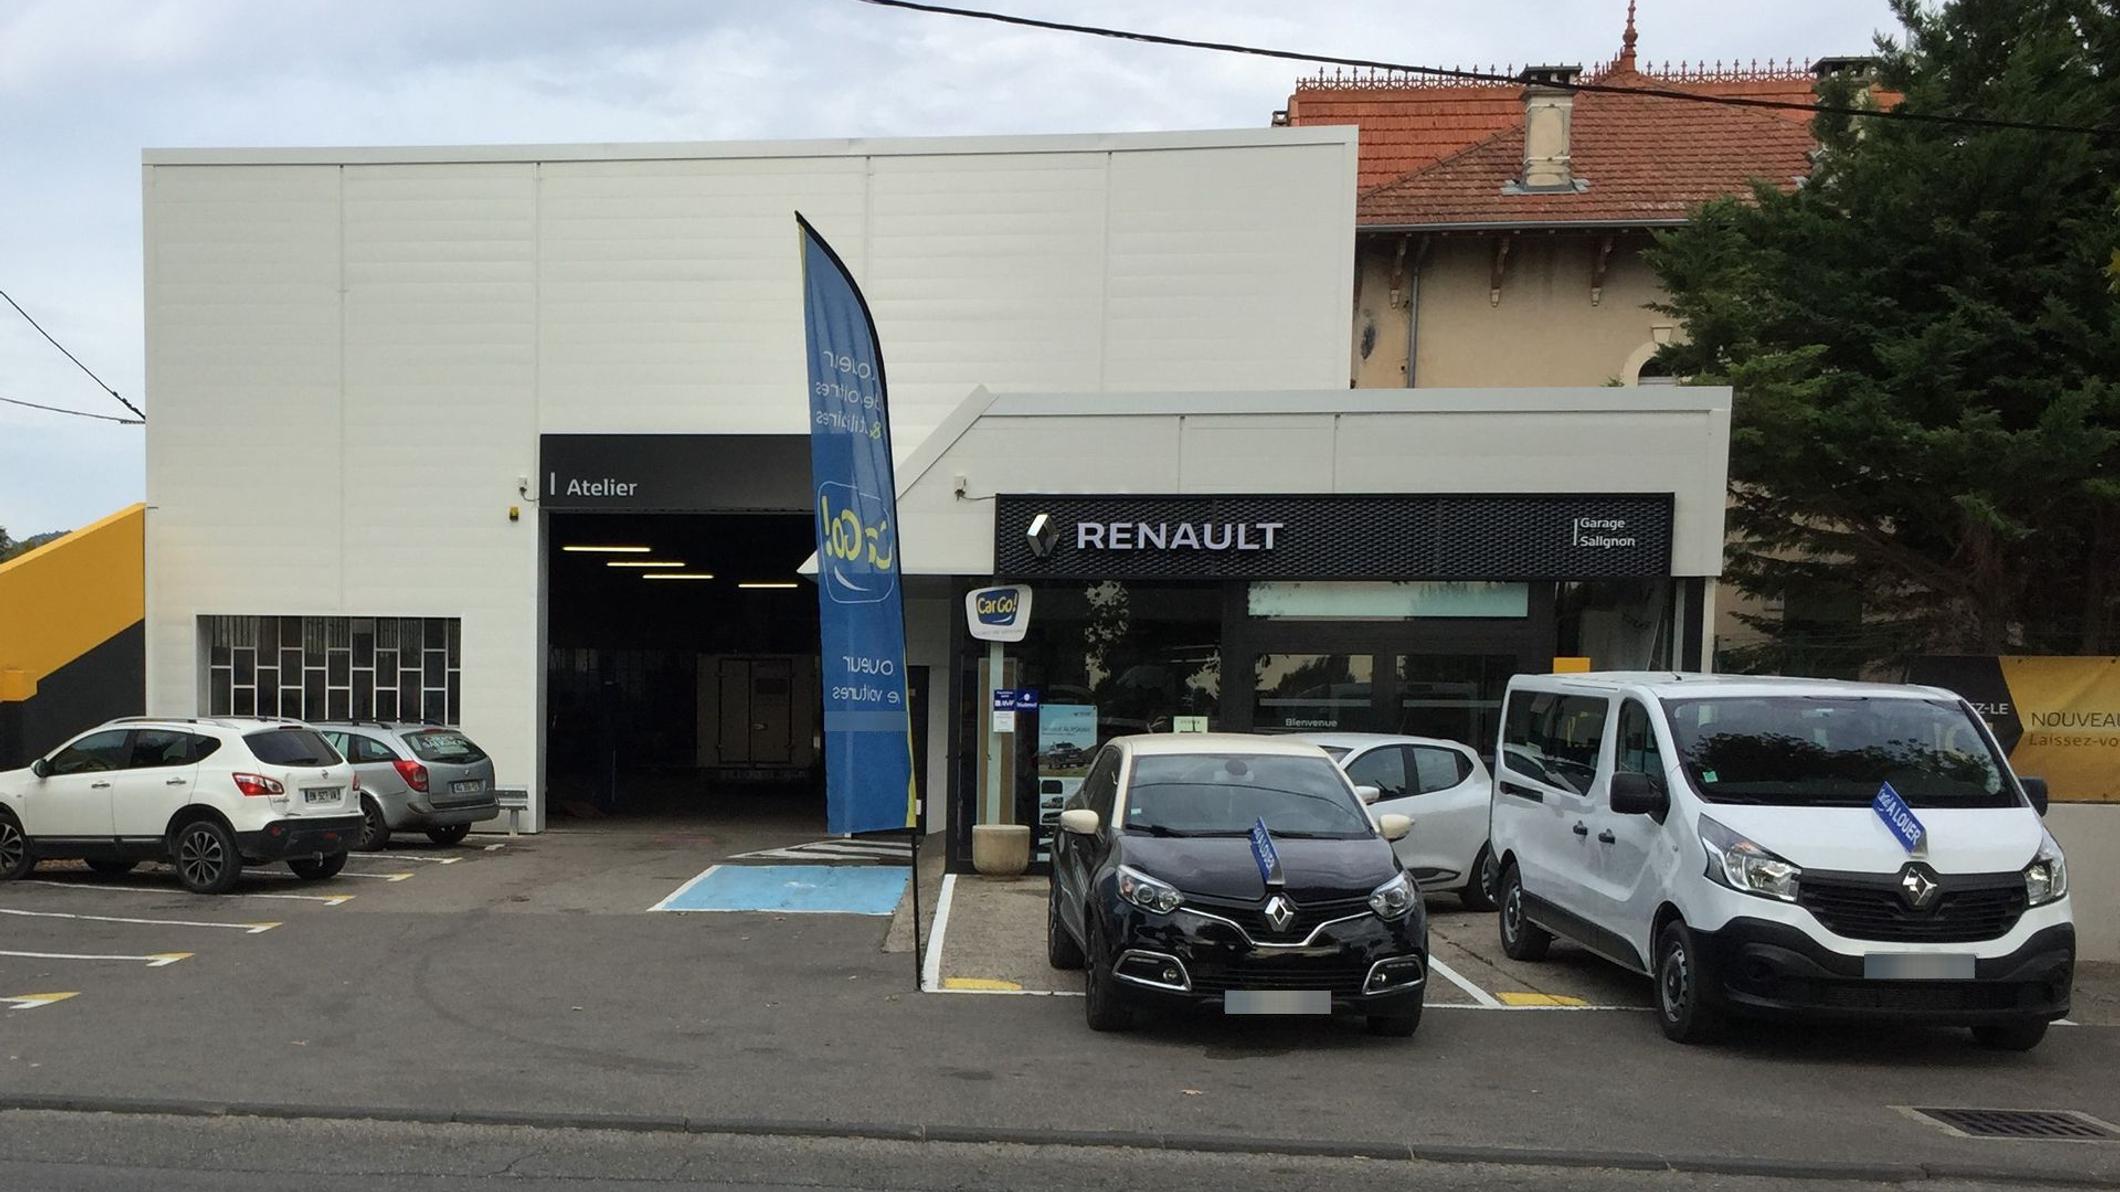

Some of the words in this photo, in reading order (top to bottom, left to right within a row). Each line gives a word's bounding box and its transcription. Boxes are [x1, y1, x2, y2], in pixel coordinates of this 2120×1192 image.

[566, 478, 639, 497] Atelier
[1580, 517, 1626, 531] Garage
[1076, 521, 1285, 551] RENAULT
[1580, 535, 1636, 549] Salignon
[1284, 717, 1338, 729] Bienvenue
[2031, 711, 2120, 728] NOUVEA
[1892, 807, 1921, 846] LOUER
